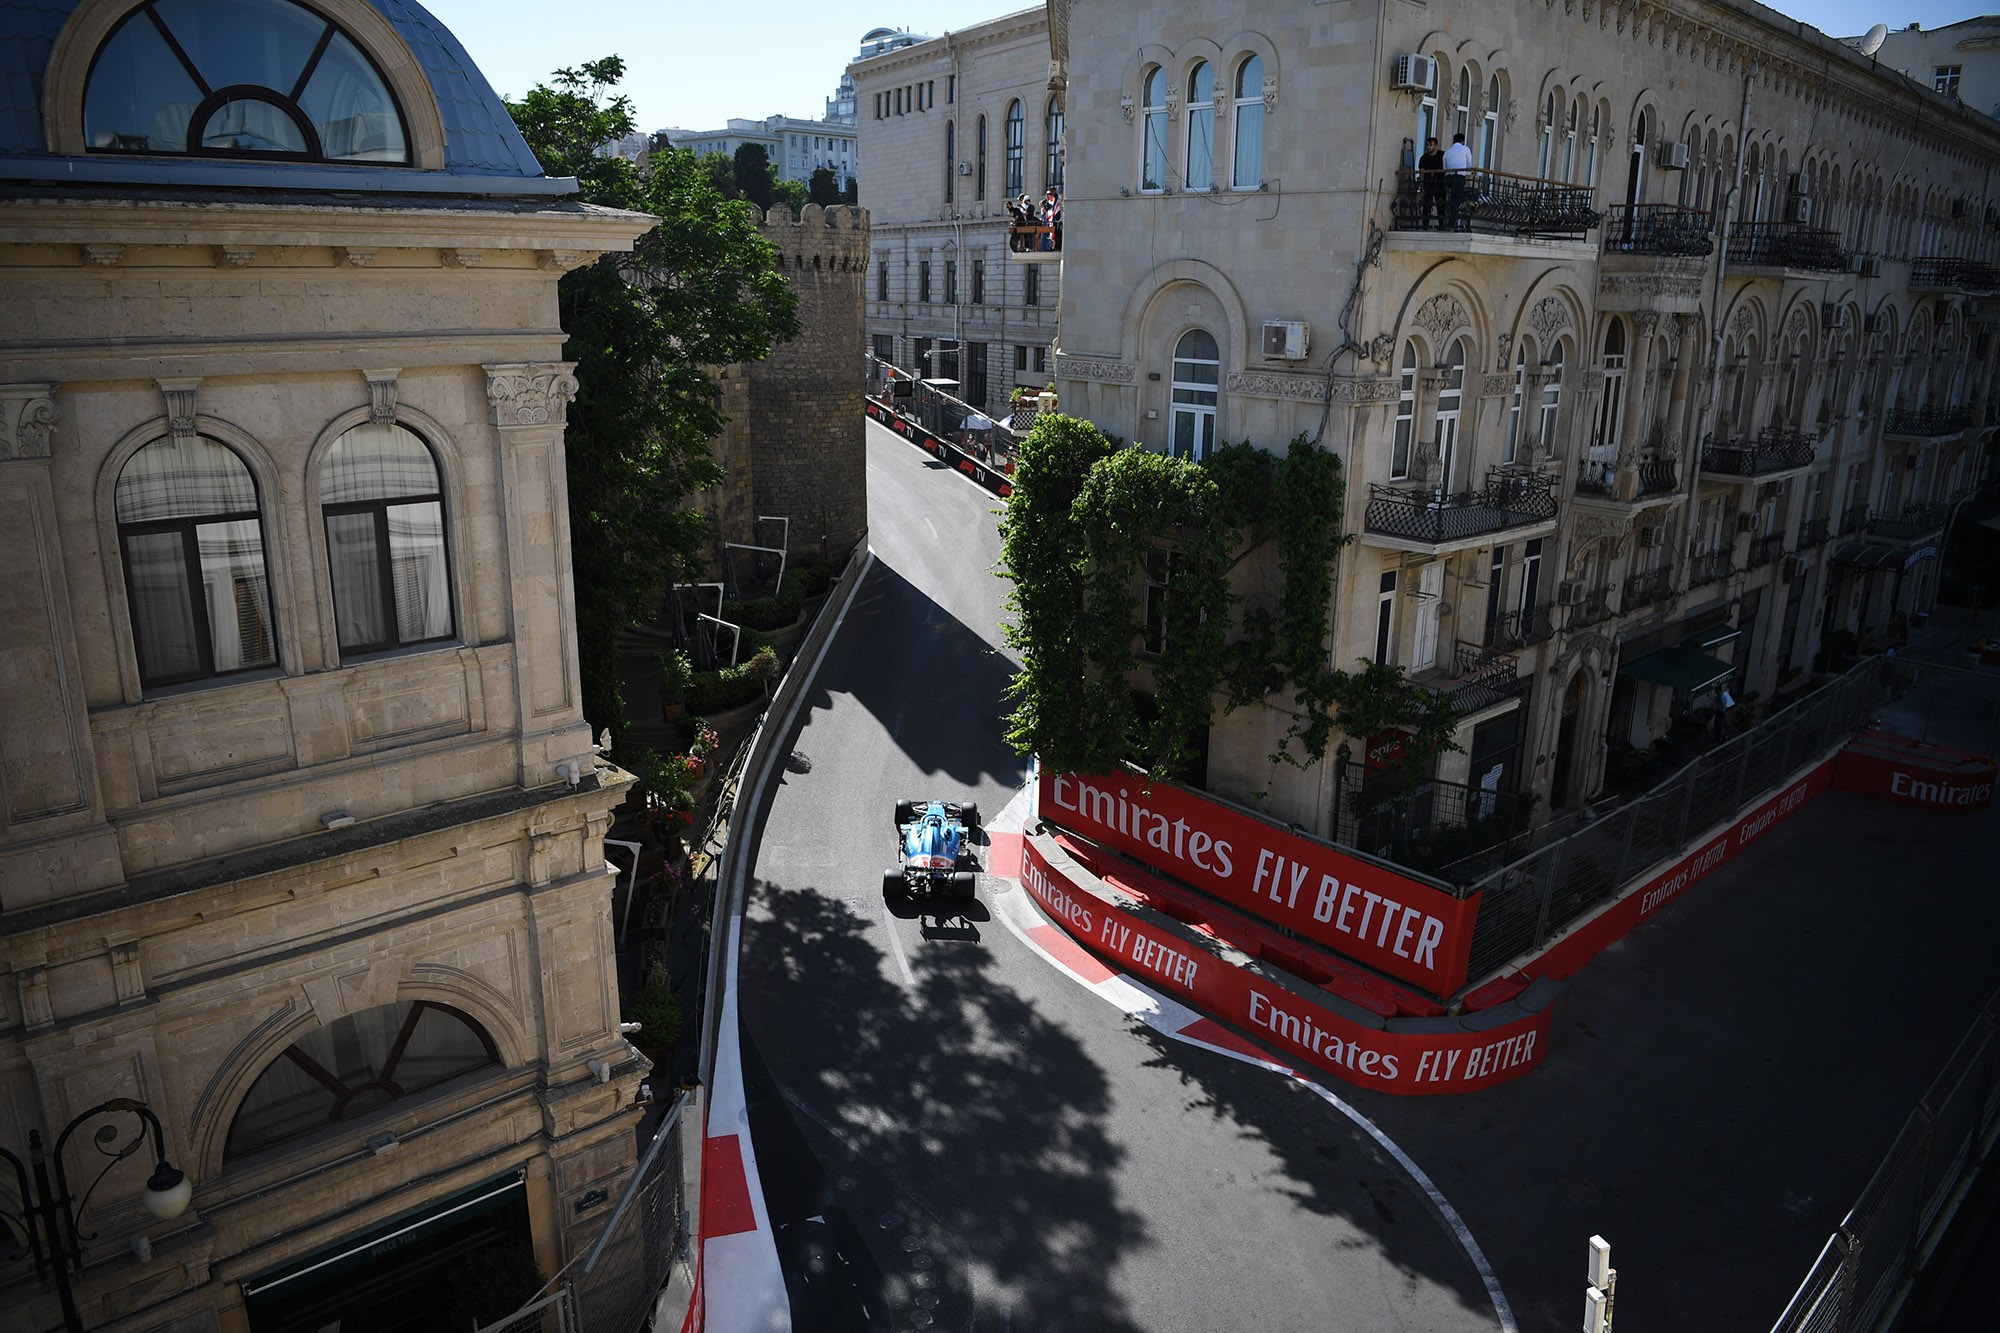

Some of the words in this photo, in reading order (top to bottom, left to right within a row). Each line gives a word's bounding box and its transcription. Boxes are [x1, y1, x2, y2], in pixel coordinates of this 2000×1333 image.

[879, 409, 887, 422] TV
[906, 425, 915, 439] TV
[938, 444, 947, 459] TV
[976, 467, 986, 482] TV
[1891, 771, 1992, 805] Emirates
[1738, 807, 1778, 847] Emirates
[1053, 771, 1233, 879] Emirates
[1252, 847, 1310, 910] FLY
[1312, 873, 1444, 971] BETTER
[1640, 869, 1689, 916] Emirates
[1022, 847, 1094, 934] Emirates
[1101, 916, 1131, 954] FLY
[1131, 932, 1199, 992] BETTER
[1249, 988, 1400, 1081] Emirates
[1414, 1049, 1462, 1083] FLY
[1463, 1029, 1537, 1082] BETTER
